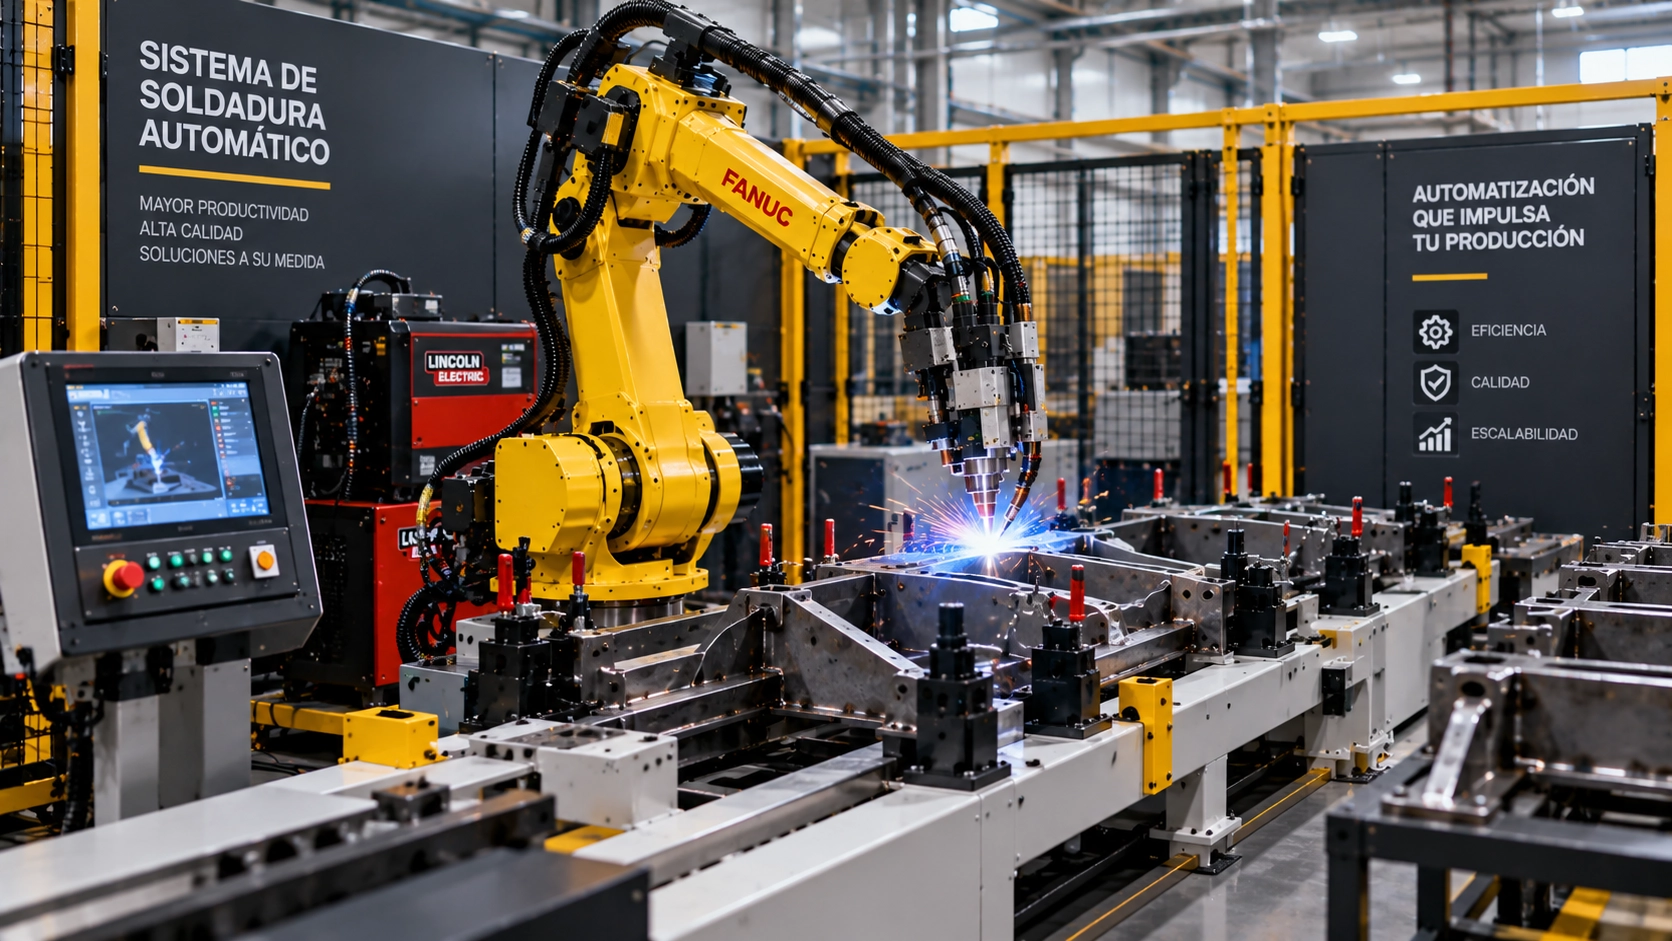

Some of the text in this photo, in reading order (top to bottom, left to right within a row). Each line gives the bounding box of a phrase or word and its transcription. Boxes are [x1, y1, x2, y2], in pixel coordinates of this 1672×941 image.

[139, 40, 317, 94] SISTEMA DE
[139, 79, 327, 131] SOLDADURA
[138, 119, 331, 166] AUTOMÁTICO
[721, 167, 793, 227] FANUC
[1412, 173, 1595, 204] AUTOMATIZACIÓN
[139, 195, 309, 222] MAYOR PRODUCTIVIDAD
[1412, 205, 1551, 229] QUE IMPULSA
[139, 221, 244, 242] ALTA CALIDAD
[1412, 225, 1585, 252] TU PRODUCCIÓN
[139, 246, 326, 270] SOLUCIONES A SU MEDIDA
[1471, 324, 1547, 337] EFICIENCIA
[427, 355, 480, 369] LINCOLN
[438, 371, 484, 382] ELECTRIC
[1471, 376, 1530, 389] CALIDAD
[1471, 427, 1579, 441] ESCALABILIDAD
